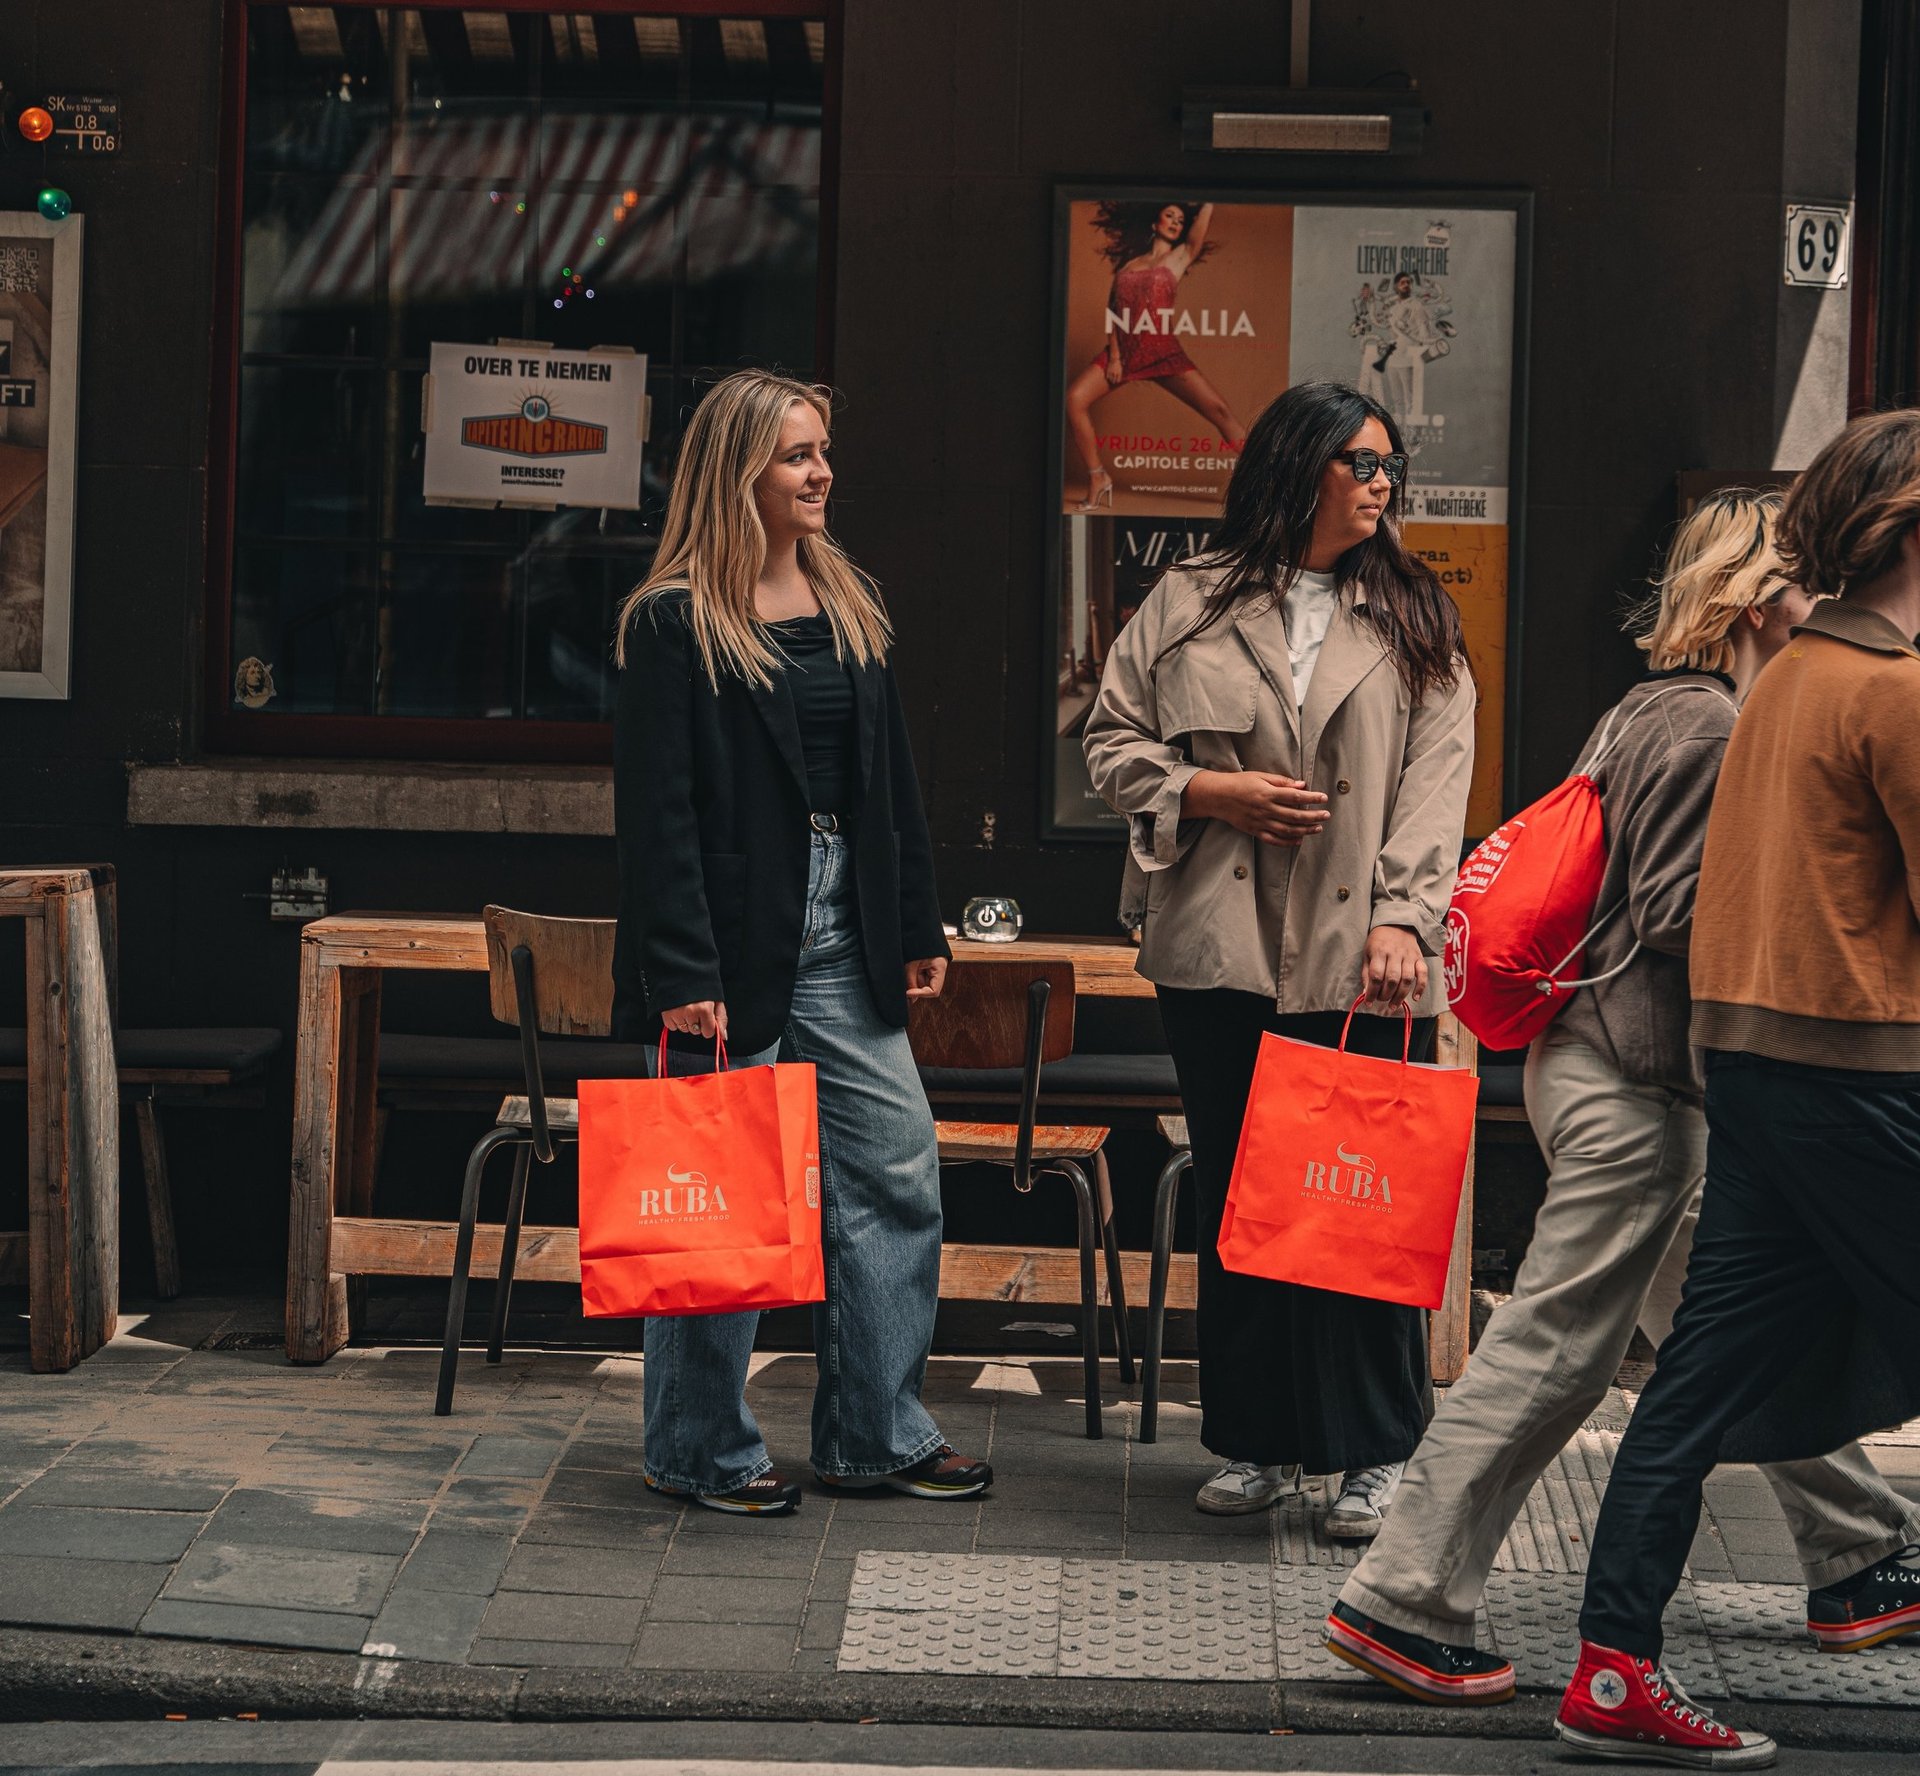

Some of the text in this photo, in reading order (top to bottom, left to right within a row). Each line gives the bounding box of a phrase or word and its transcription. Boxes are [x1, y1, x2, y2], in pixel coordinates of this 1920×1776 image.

[48, 96, 66, 111] SK
[1797, 218, 1838, 273] 69
[1357, 245, 1450, 276] LIEVEN SCHEIRE
[1104, 308, 1256, 337] NATALIA
[464, 356, 612, 382] OVER TE NEMEN
[1095, 436, 1182, 453] VRIJDAG
[1190, 438, 1212, 452] 26
[501, 465, 565, 479] INTERESSE?
[1113, 455, 1237, 470] CAPITOLE GENT
[1412, 489, 1438, 497] MEI
[1425, 498, 1487, 518] WACHTEBEKE
[1303, 1160, 1392, 1204] RUBA
[639, 1184, 729, 1216] RUBA
[1300, 1191, 1393, 1214] HEALTHY FRESH FOOD
[638, 1217, 674, 1225] HEALTHY
[708, 1214, 730, 1222] FOOD
